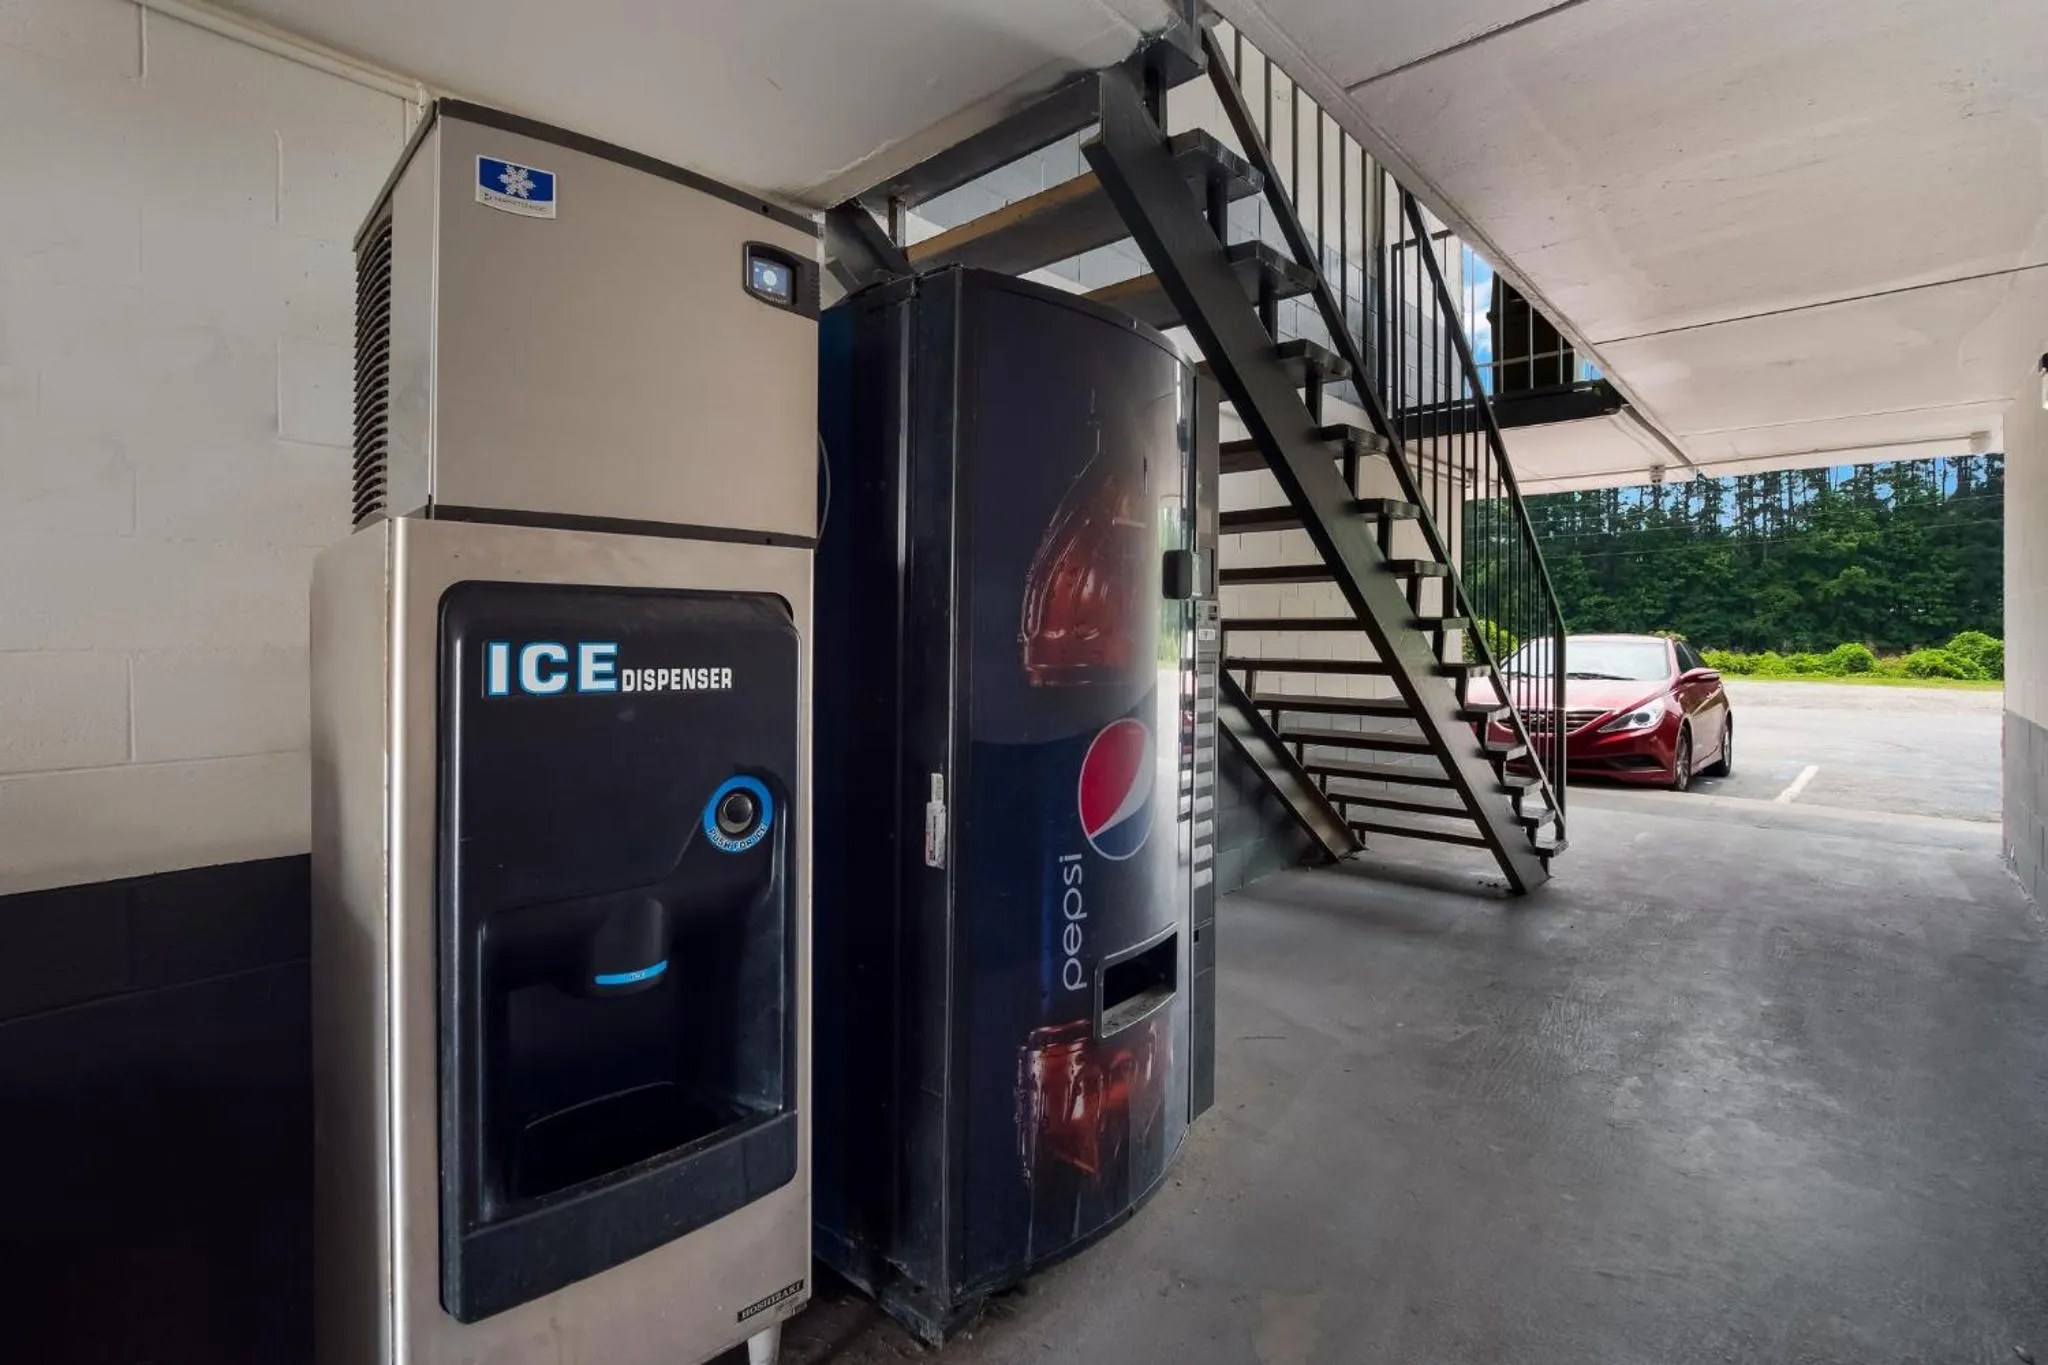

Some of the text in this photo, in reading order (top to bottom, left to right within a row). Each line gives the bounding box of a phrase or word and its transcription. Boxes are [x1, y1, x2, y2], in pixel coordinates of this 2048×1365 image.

[488, 642, 732, 695] ICE DISPENSER
[1059, 853, 1088, 991] pepsi
